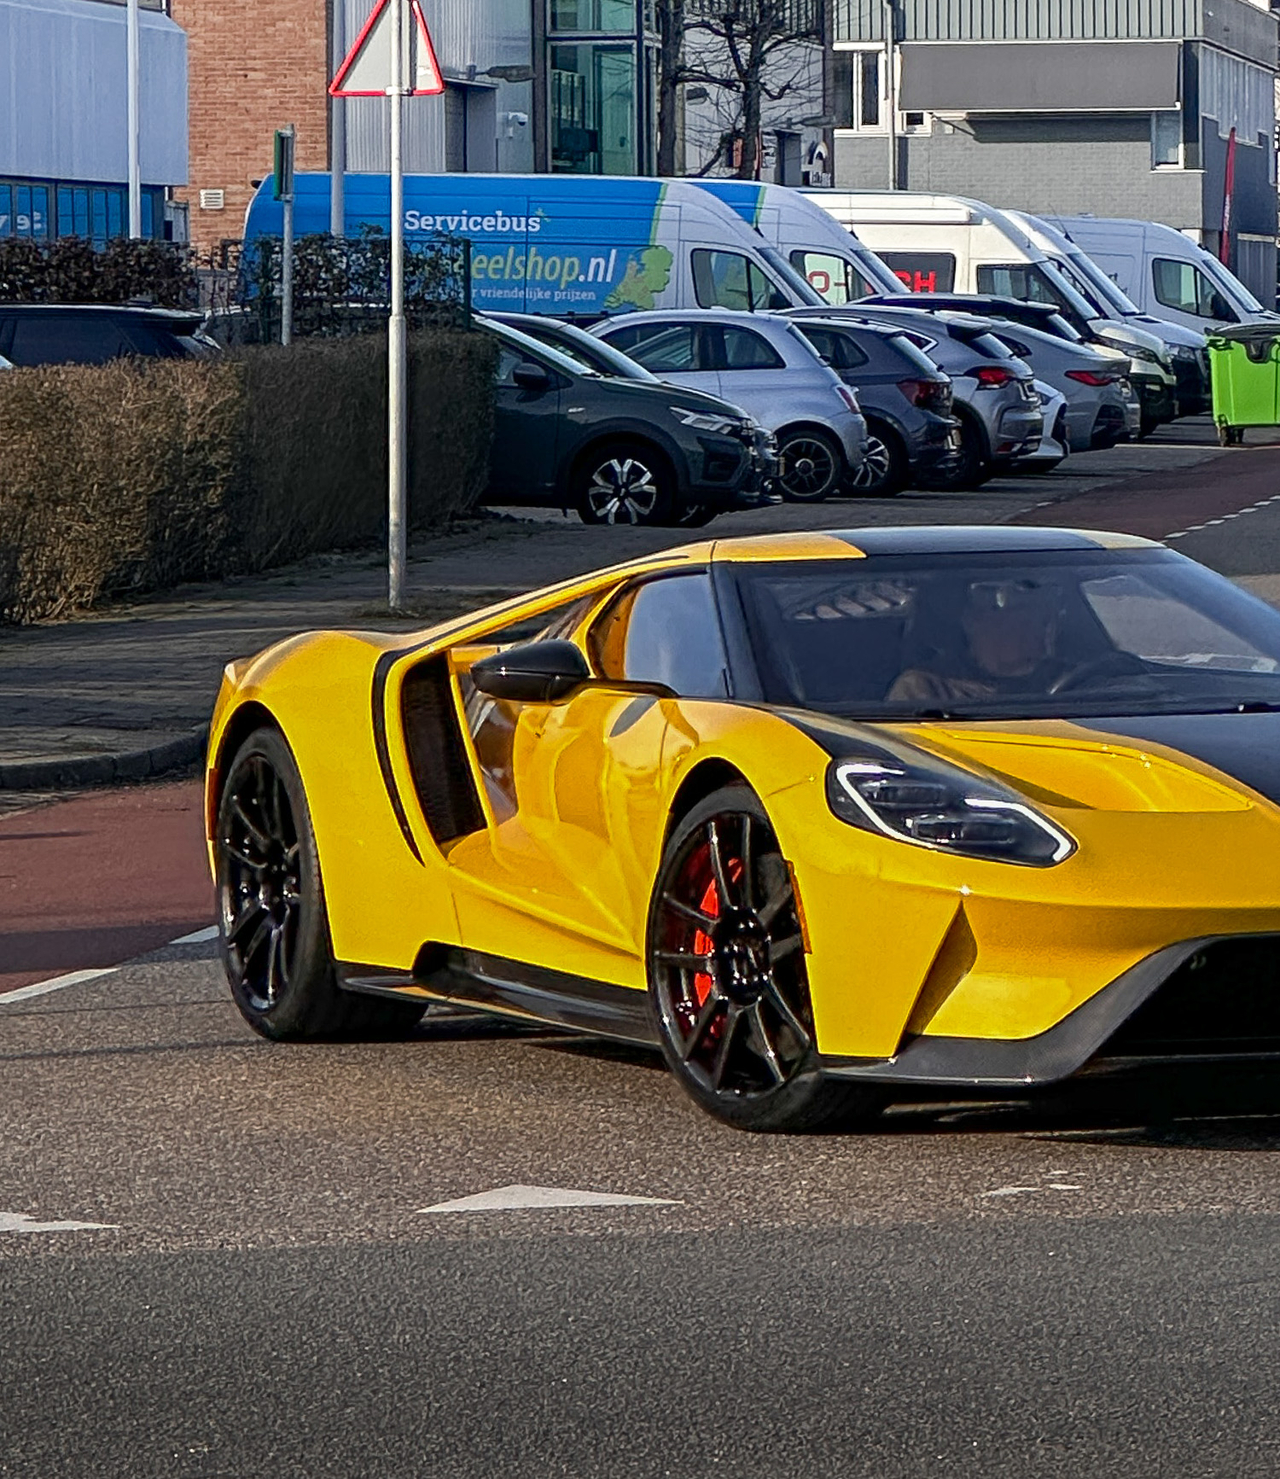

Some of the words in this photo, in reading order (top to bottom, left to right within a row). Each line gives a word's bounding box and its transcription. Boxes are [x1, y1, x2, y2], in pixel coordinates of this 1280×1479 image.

[404, 210, 541, 232] Servicebus
[471, 246, 617, 289] eelshop.nl
[480, 287, 551, 301] vriendelijke
[554, 290, 596, 301] prijzen
